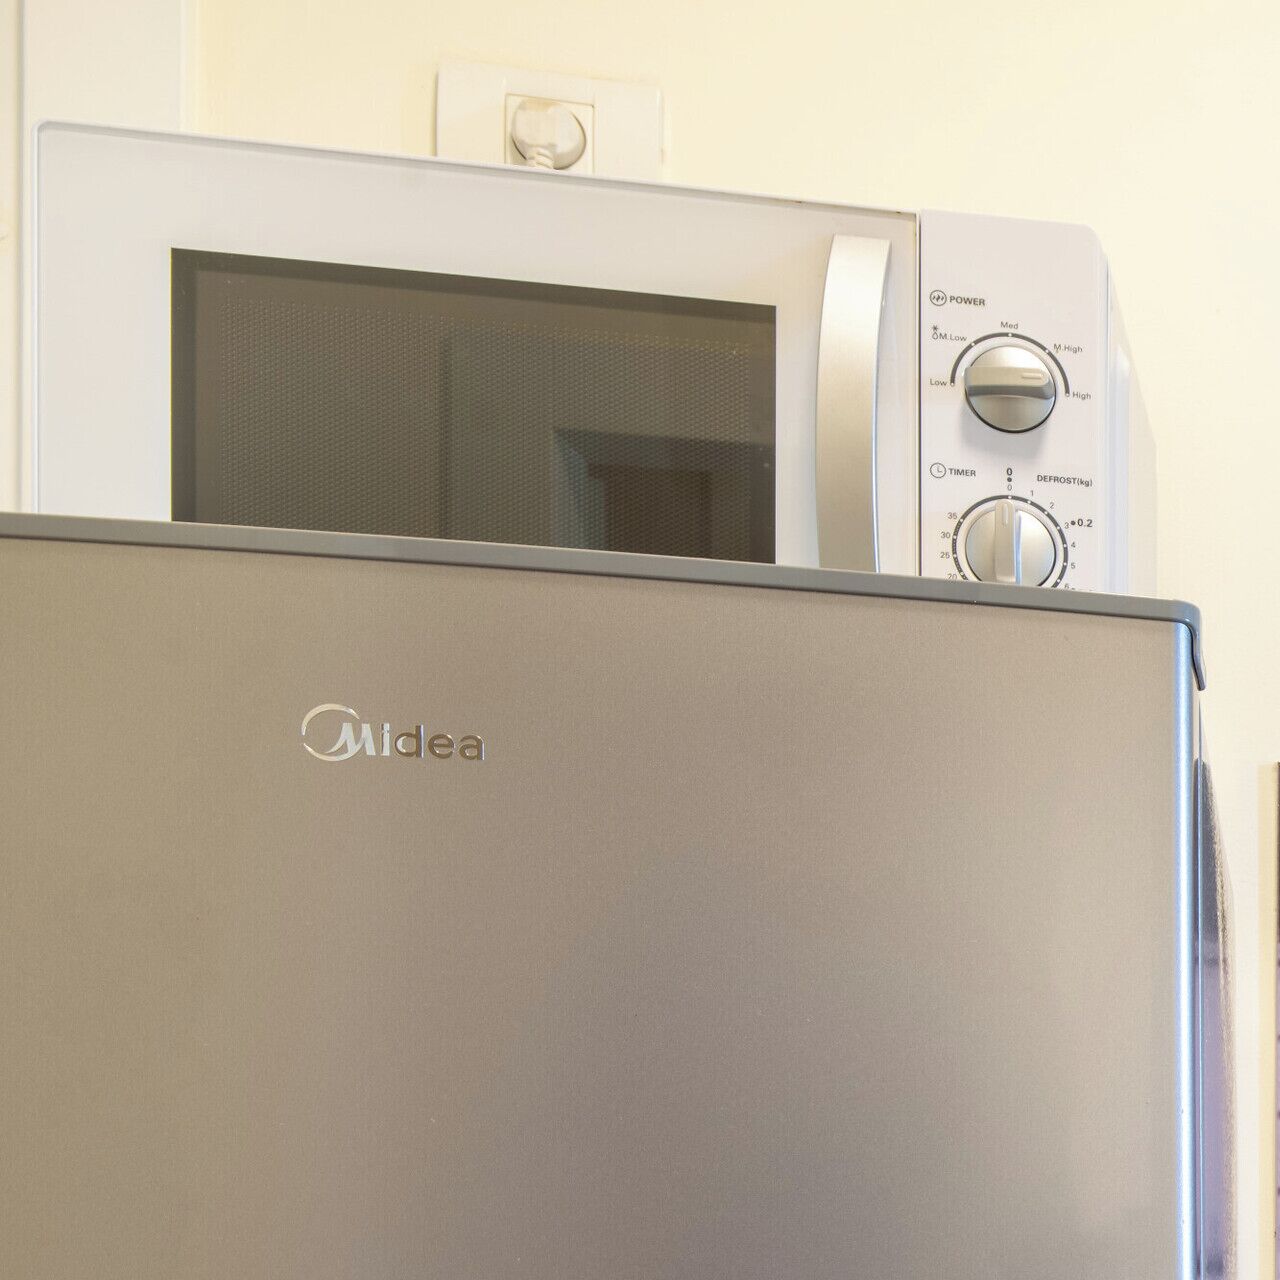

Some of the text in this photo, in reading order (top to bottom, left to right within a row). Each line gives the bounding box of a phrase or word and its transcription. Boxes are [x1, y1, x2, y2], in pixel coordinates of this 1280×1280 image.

[949, 295, 986, 307] POWER
[1000, 320, 1019, 330] Med
[1053, 343, 1083, 354] M.High
[929, 378, 948, 387] Low
[1072, 391, 1092, 401] High
[948, 467, 977, 478] TIMER
[1036, 474, 1094, 488] DEFROST(kg)
[947, 512, 958, 520] 35
[1077, 518, 1093, 528] 0.2
[940, 531, 951, 539] 30
[1070, 541, 1076, 549] 4
[940, 551, 951, 560] 25
[302, 716, 485, 762] Midea
